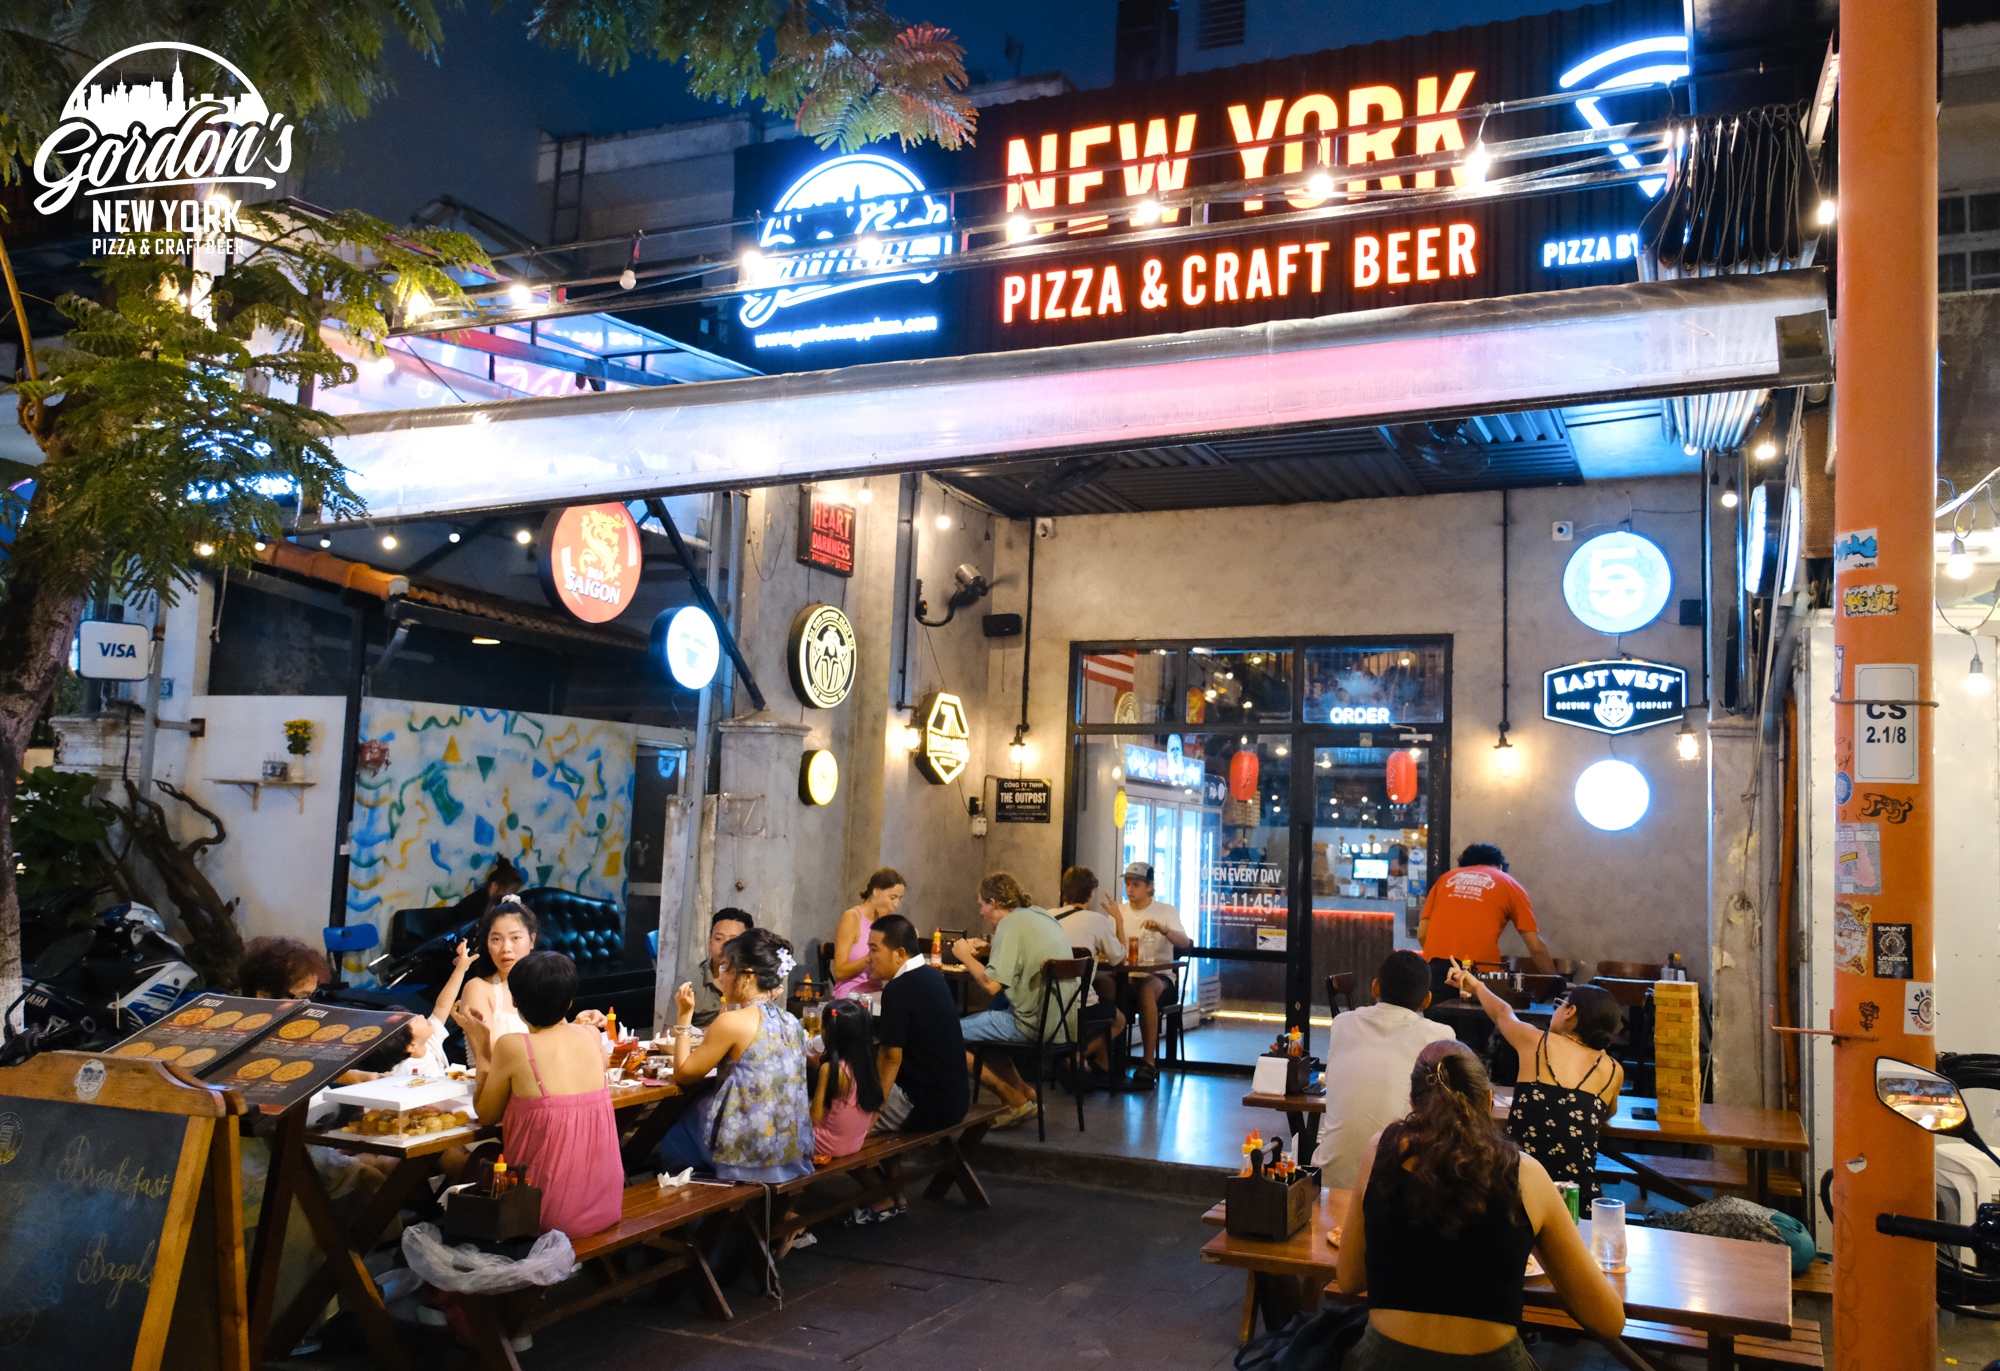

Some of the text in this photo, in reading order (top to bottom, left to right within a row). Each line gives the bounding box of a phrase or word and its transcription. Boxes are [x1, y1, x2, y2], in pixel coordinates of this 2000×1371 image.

[1006, 70, 1476, 236] NEW YORK
[1543, 236, 1612, 268] PIZZA
[1003, 222, 1477, 324] PIZZA & CRAFT BEER
[812, 500, 852, 539] HEART
[811, 531, 851, 561] DARKNESS
[586, 566, 605, 583] BIA
[564, 570, 622, 606] SAIGON
[97, 642, 137, 658] VISA
[1553, 668, 1677, 695] EAST WEST
[1555, 701, 1673, 711] BREWING COMPANY
[1866, 702, 1908, 720] CS
[1330, 707, 1389, 724] ORDER
[1866, 726, 1907, 744] 2.1/8
[1000, 792, 1047, 803] THE OUTPOST
[1228, 867, 1259, 882] EVERY
[1260, 868, 1282, 883] DAY
[24, 992, 49, 1009] AHA
[198, 999, 223, 1008] PIZZA
[302, 1007, 330, 1019] PIZZA
[57, 1135, 171, 1210] Breakfast
